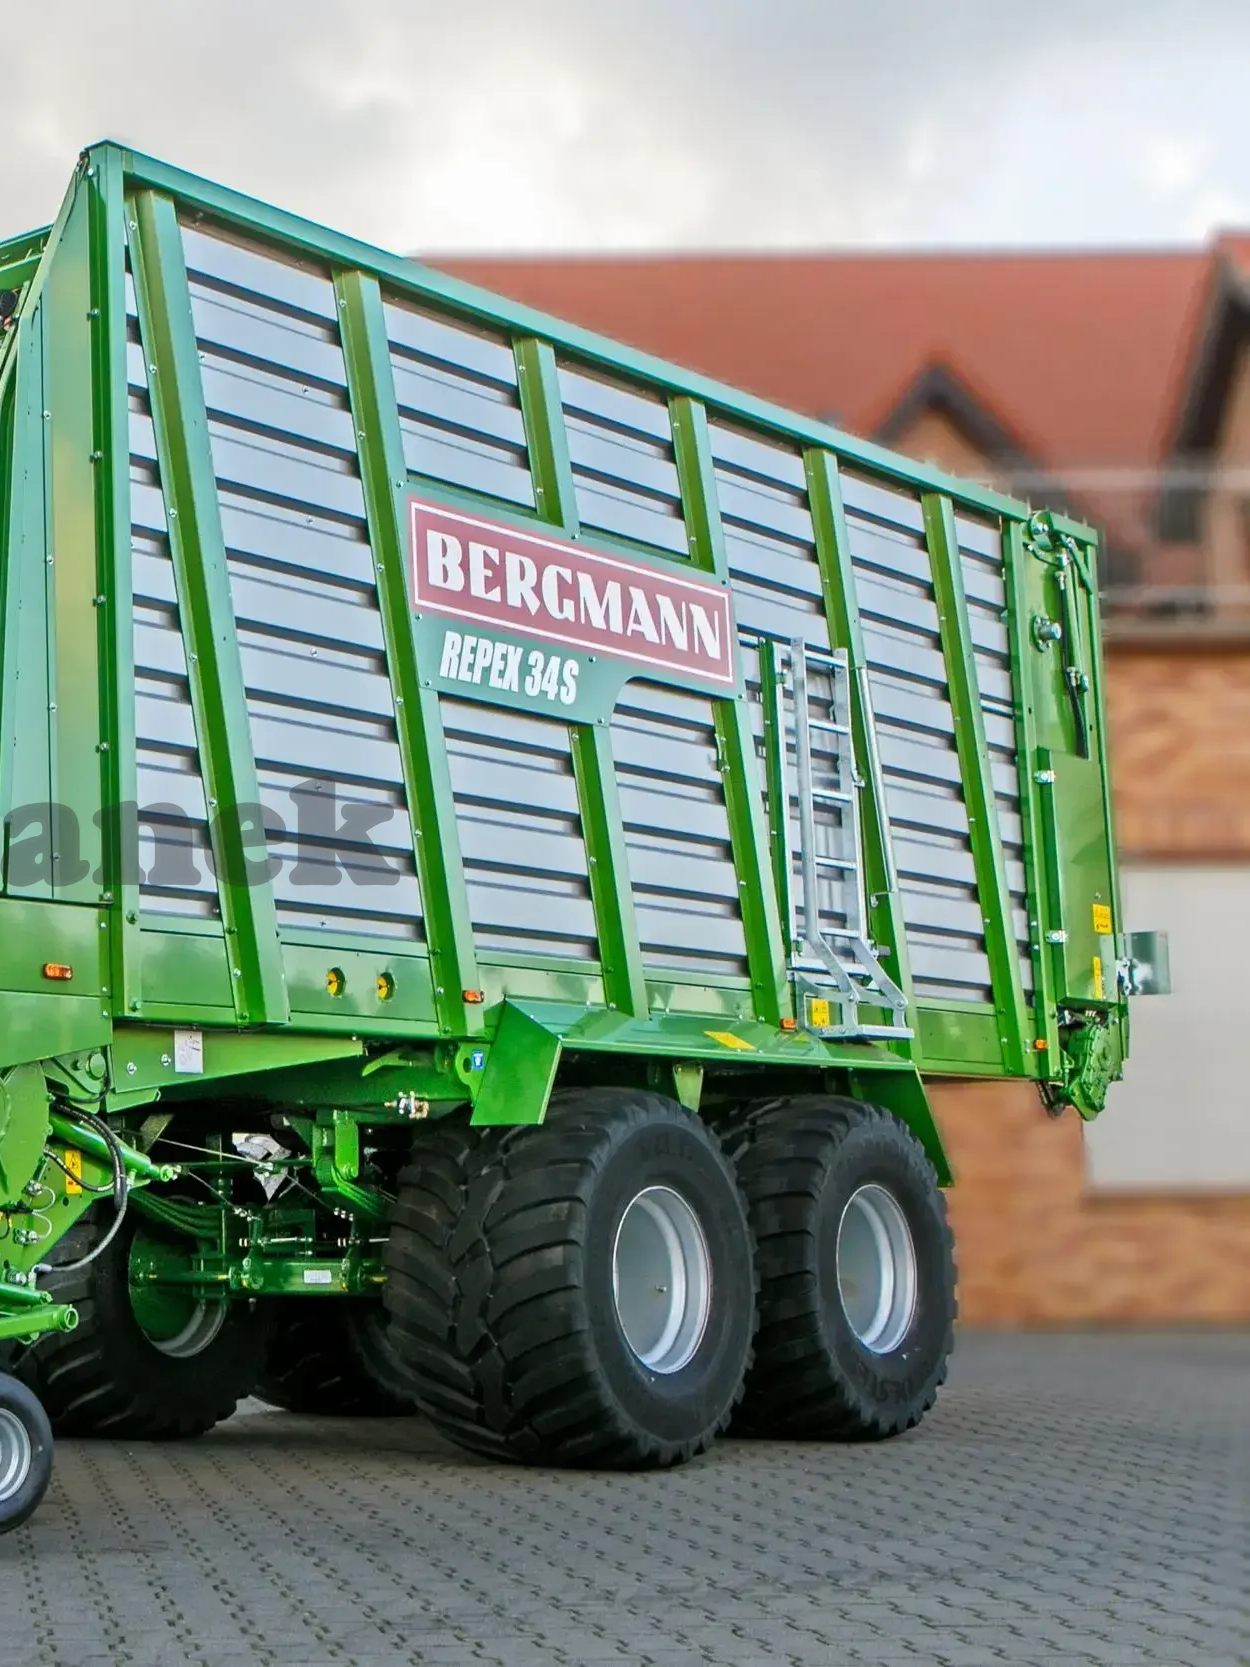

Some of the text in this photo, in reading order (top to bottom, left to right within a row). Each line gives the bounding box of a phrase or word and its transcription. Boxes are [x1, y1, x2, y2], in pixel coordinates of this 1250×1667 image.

[427, 530, 721, 660] BERGMANN
[439, 631, 579, 705] REPEX 34S
